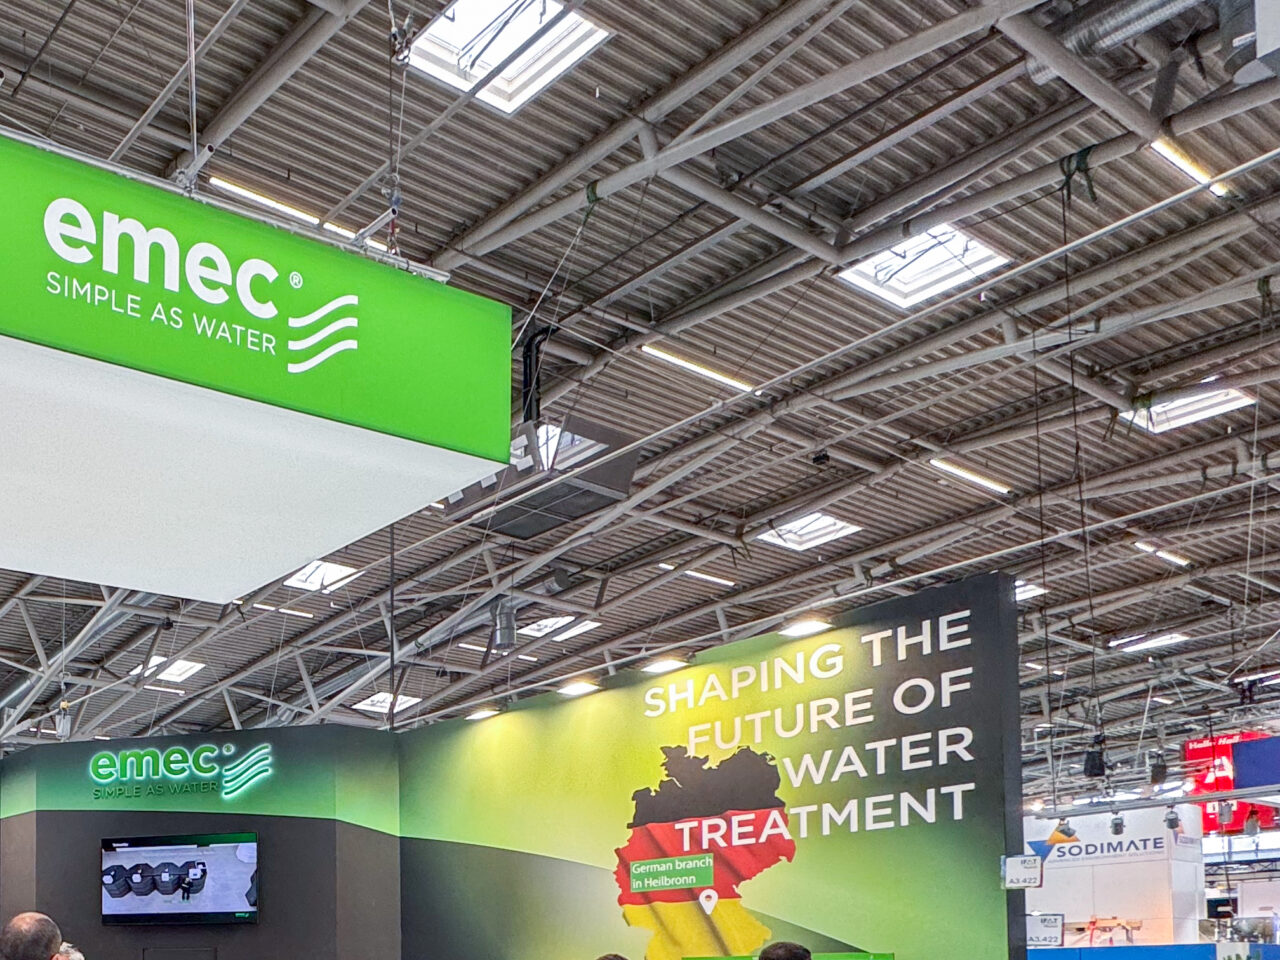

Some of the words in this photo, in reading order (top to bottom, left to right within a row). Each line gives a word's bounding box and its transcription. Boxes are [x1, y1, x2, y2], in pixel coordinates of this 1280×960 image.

[43, 197, 278, 319] emec
[46, 271, 141, 318] SIMPLE
[151, 302, 183, 329] AS
[192, 312, 276, 355] WATER
[644, 643, 844, 718] SHAPING
[861, 609, 971, 667] THE
[687, 688, 874, 758] FUTURE
[893, 666, 973, 715] OF
[90, 744, 219, 782] emec
[782, 726, 975, 788] WATER
[92, 785, 141, 800] SIMPLE
[146, 784, 164, 796] AS
[169, 781, 219, 793] WATER
[674, 782, 976, 852] TREATMENT
[632, 862, 673, 874] German
[675, 857, 713, 870] branch
[1056, 836, 1165, 858] SODIMATE
[632, 879, 642, 889] in
[644, 875, 696, 888] Heilbronn
